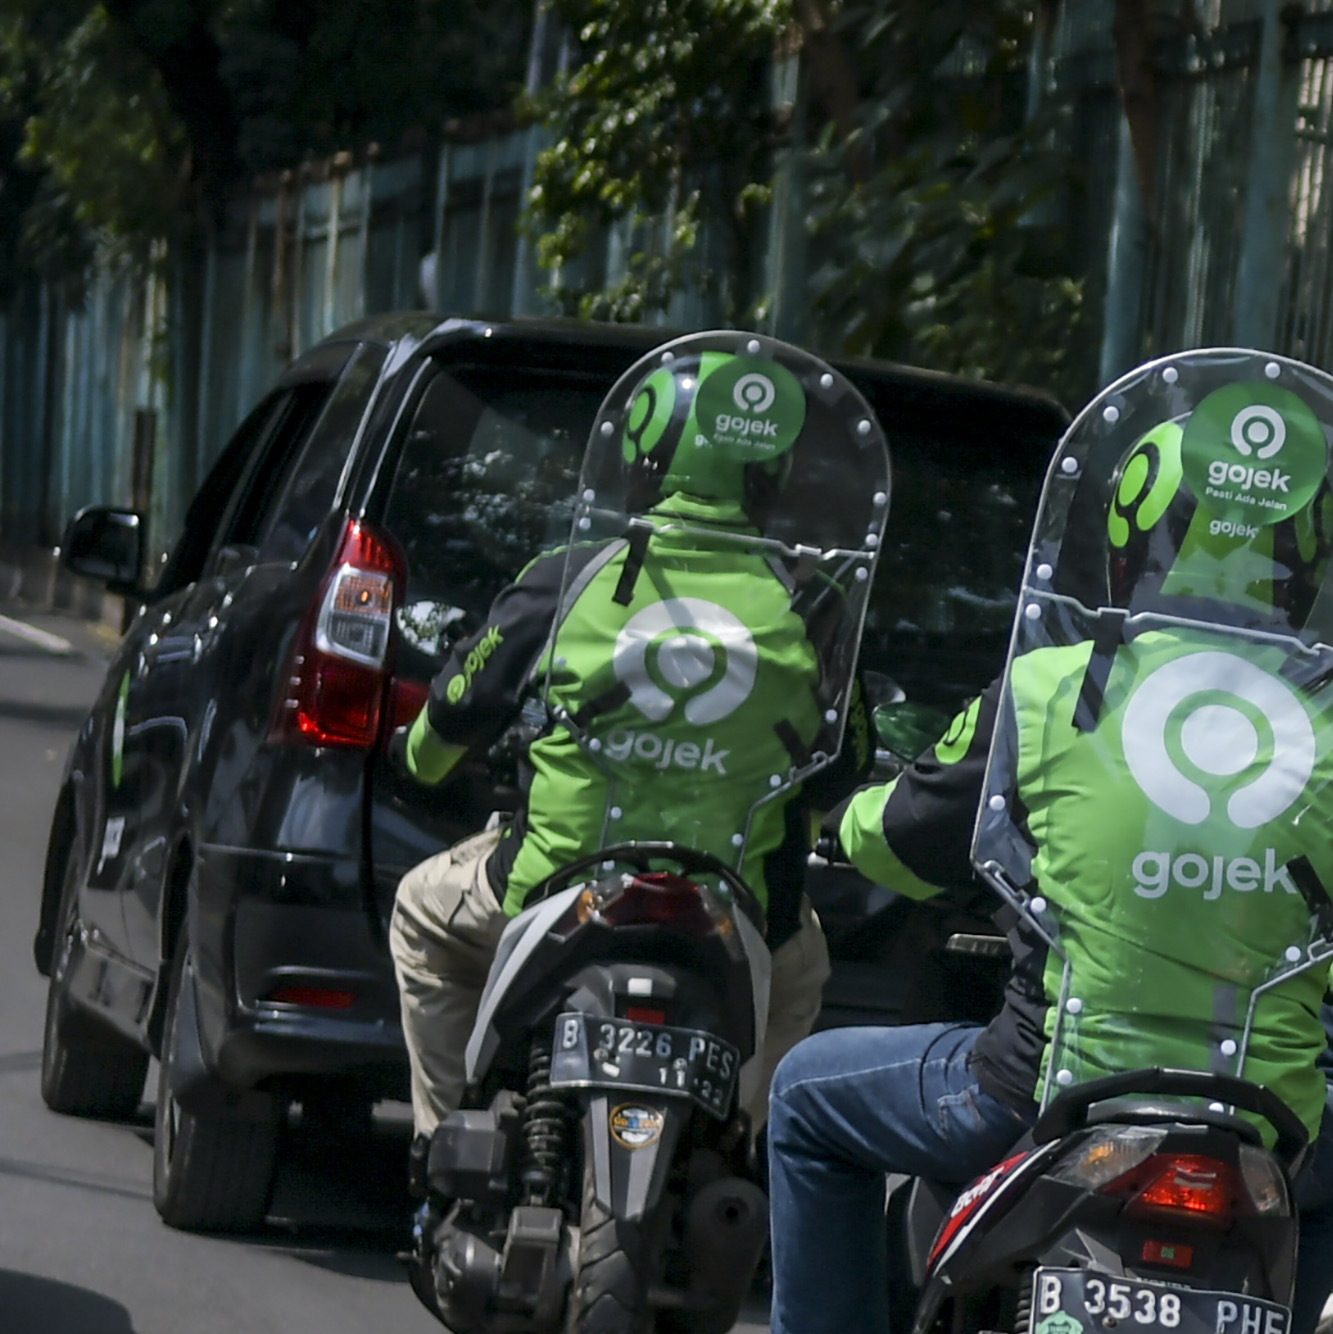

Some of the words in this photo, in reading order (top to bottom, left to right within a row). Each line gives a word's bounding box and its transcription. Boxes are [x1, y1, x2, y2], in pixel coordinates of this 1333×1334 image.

[716, 413, 778, 436] gojek
[1208, 461, 1291, 492] gojek
[1205, 486, 1233, 500] Pasti
[1235, 492, 1256, 505] Ada
[1258, 497, 1287, 511] Jalan
[1210, 519, 1259, 539] gojek
[604, 729, 730, 775] gojek
[1132, 848, 1298, 900] gojek
[562, 1019, 579, 1048] B
[600, 1023, 672, 1059] 3226
[689, 1036, 734, 1080] PES
[1040, 1276, 1062, 1314] B
[1084, 1279, 1182, 1327] 3538
